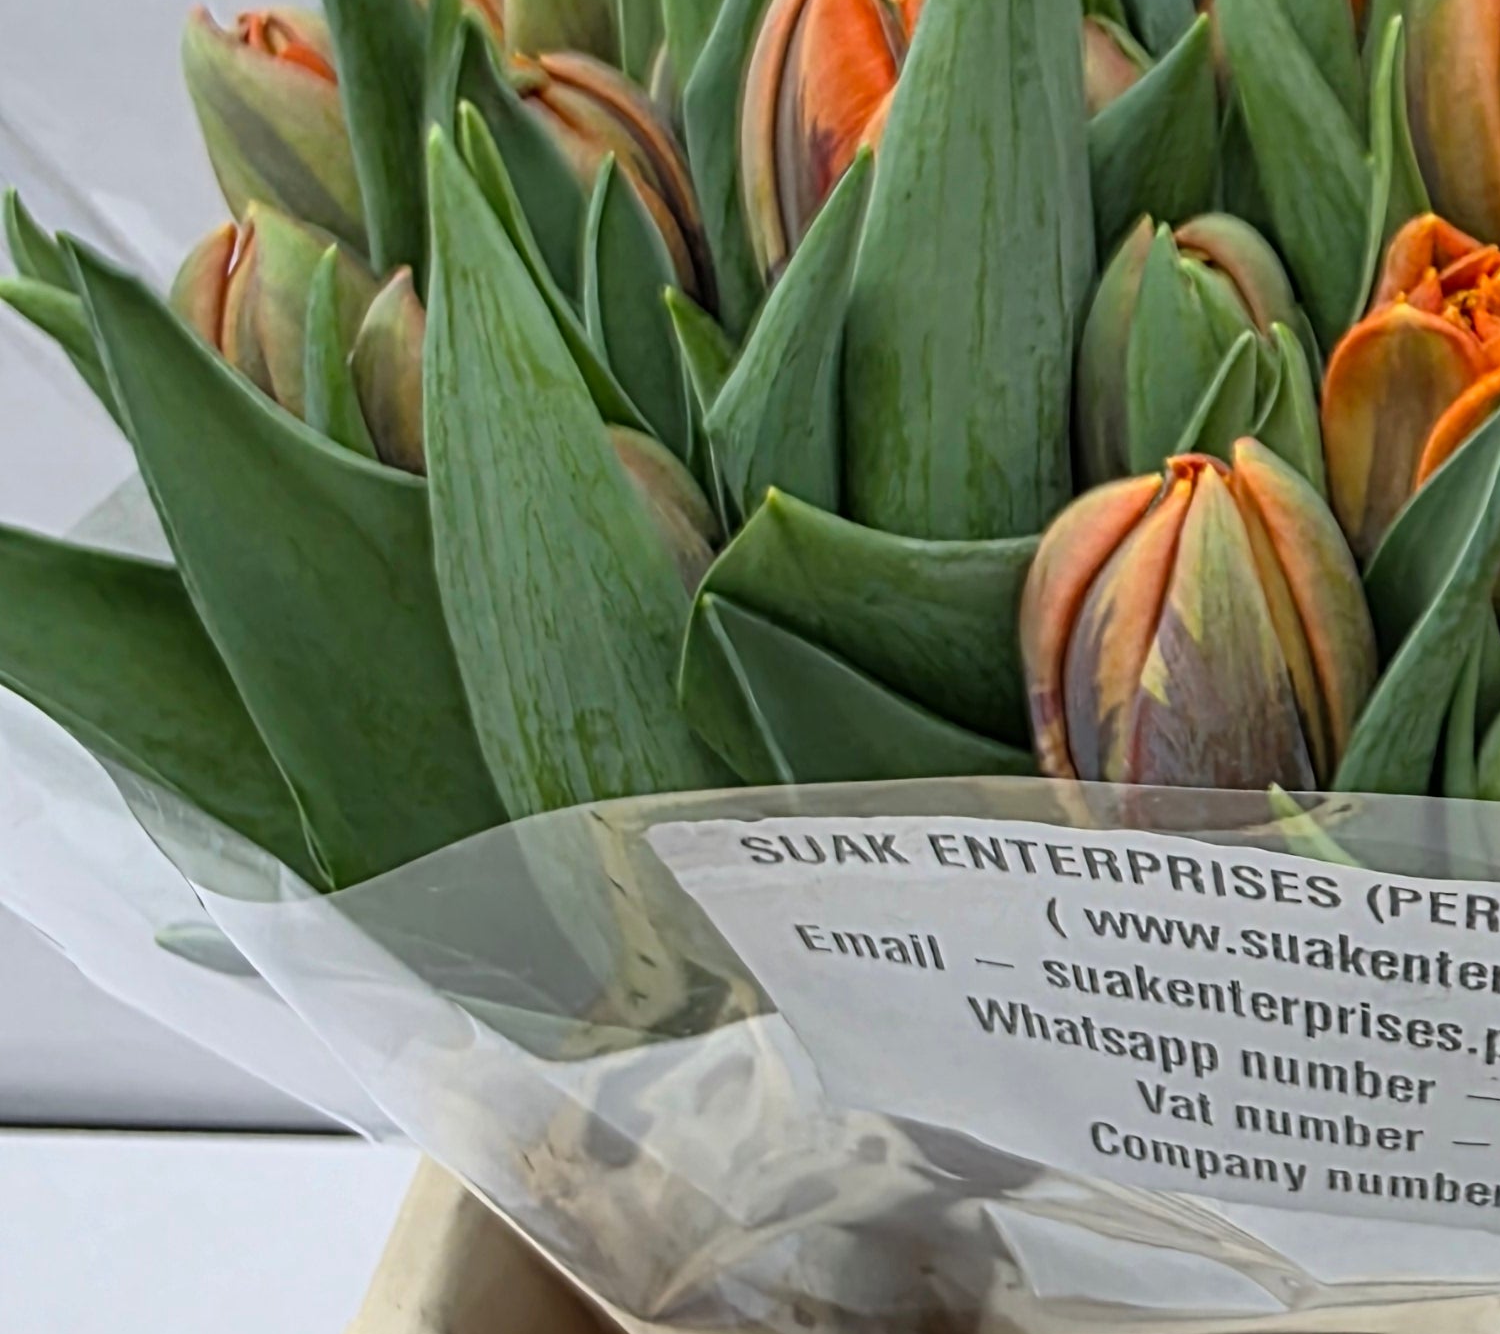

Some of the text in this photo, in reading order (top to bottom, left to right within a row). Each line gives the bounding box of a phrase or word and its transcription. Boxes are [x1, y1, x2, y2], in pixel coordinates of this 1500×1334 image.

[740, 833, 909, 866] SUAK
[927, 833, 1342, 908] ENTERPRISES
[794, 923, 946, 971] Email
[966, 995, 1219, 1076] Whatsapp
[1240, 1048, 1436, 1105] number
[1135, 1079, 1213, 1126] Vat
[1235, 1102, 1425, 1152] number
[1090, 1120, 1306, 1192] Company
